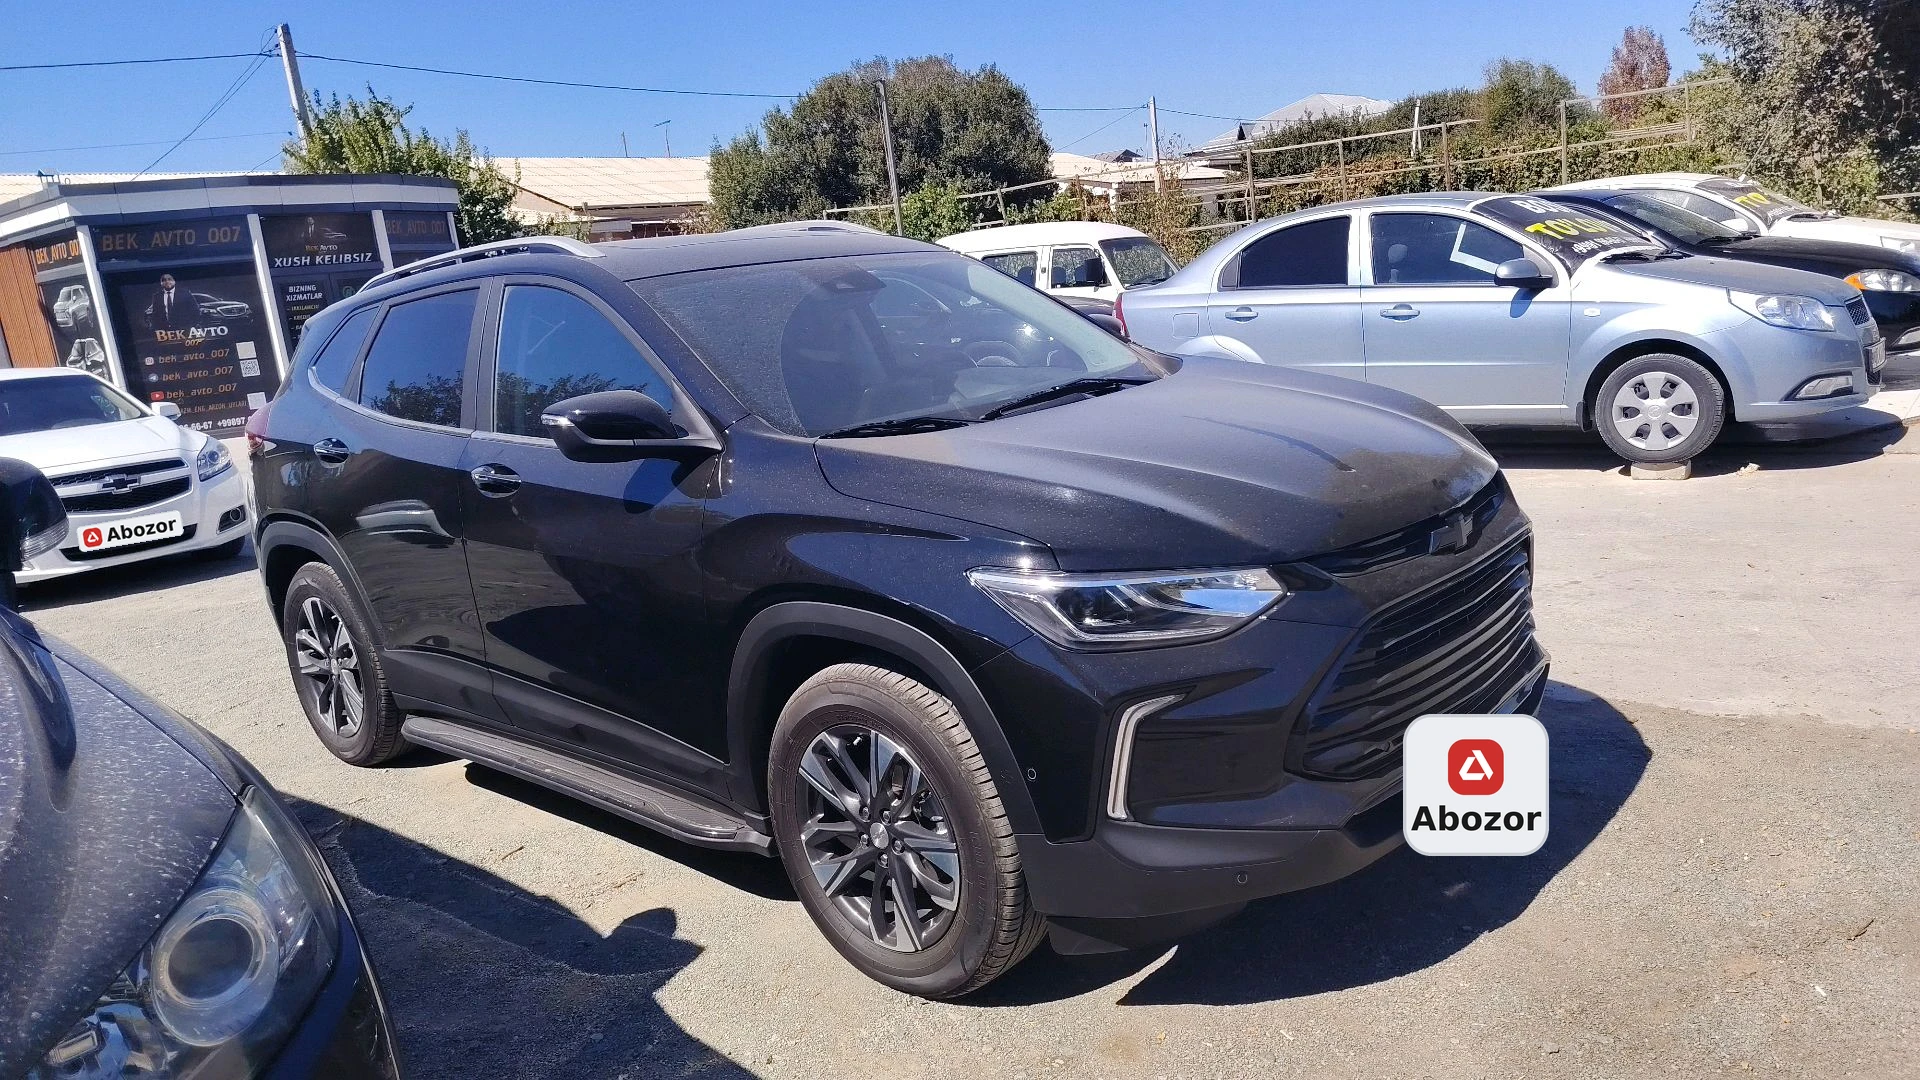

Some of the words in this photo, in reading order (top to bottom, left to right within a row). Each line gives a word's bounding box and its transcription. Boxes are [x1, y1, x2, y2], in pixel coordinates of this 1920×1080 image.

[275, 256, 310, 268] XUSH
[316, 252, 373, 265] KELIBSIZ
[288, 285, 317, 293] BIZNING
[286, 293, 323, 302] XIZMATLAR
[154, 329, 185, 342] BEK
[188, 326, 229, 339] AVTO
